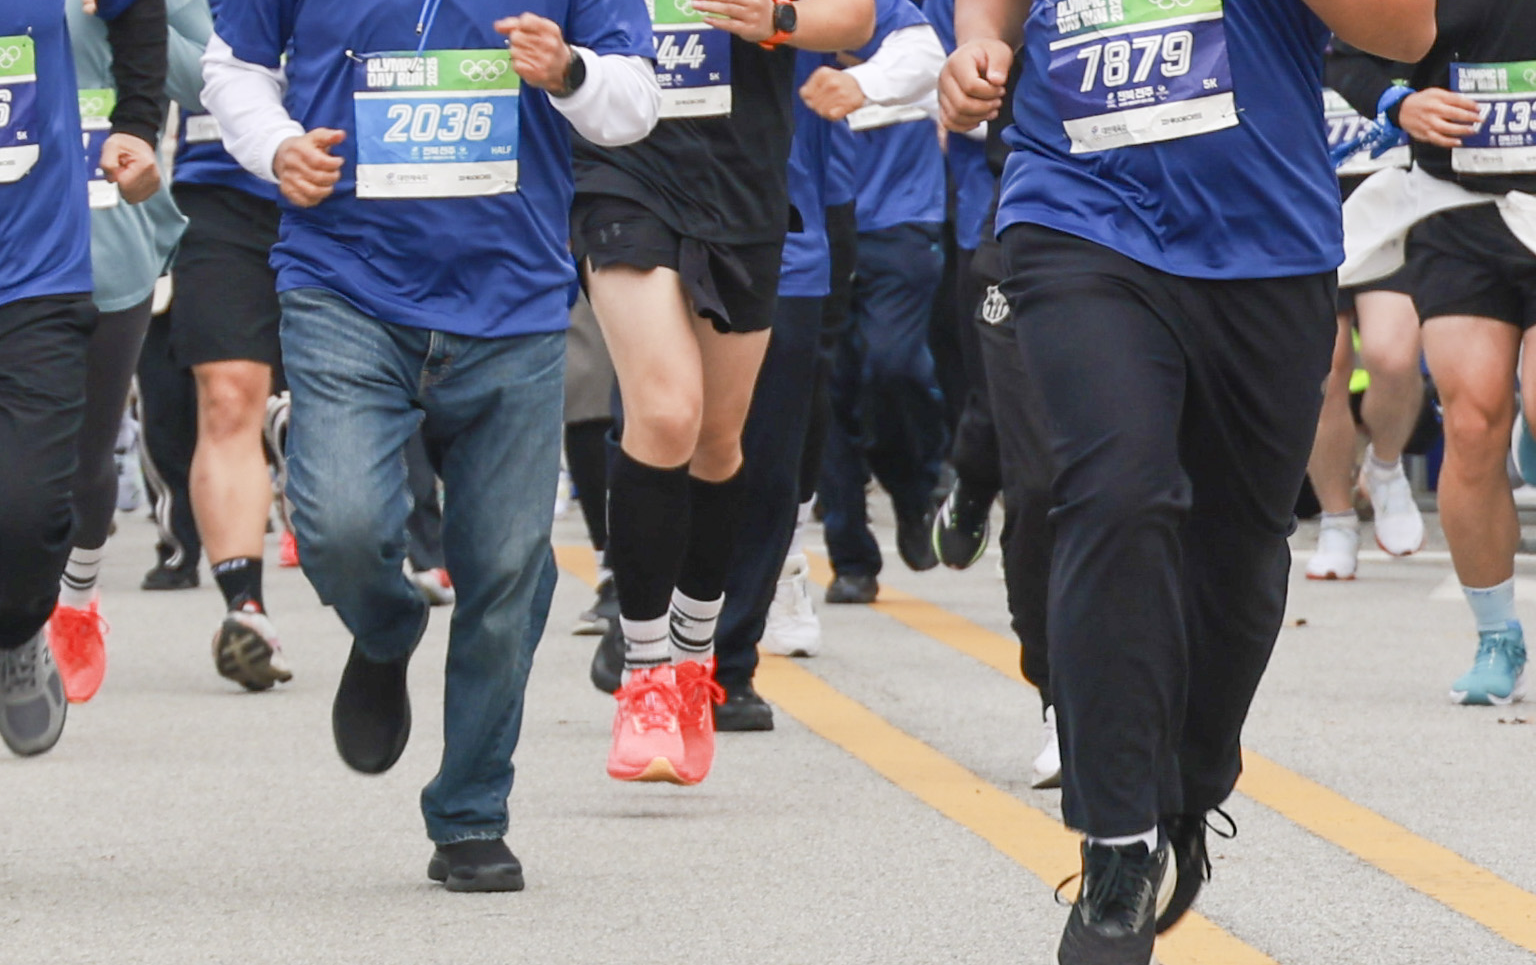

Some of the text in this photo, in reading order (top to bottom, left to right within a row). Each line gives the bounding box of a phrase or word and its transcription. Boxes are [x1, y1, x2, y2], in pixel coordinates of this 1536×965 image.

[1056, 15, 1082, 35] DAY
[652, 33, 706, 71] 44
[367, 57, 425, 73] OLYMPIC
[1077, 30, 1193, 93] 7879
[367, 72, 395, 87] DAY
[709, 72, 720, 82] 5K
[1202, 78, 1218, 90] 5K
[382, 102, 494, 143] 2036
[16, 130, 28, 141] 5K
[490, 145, 513, 155] HALF
